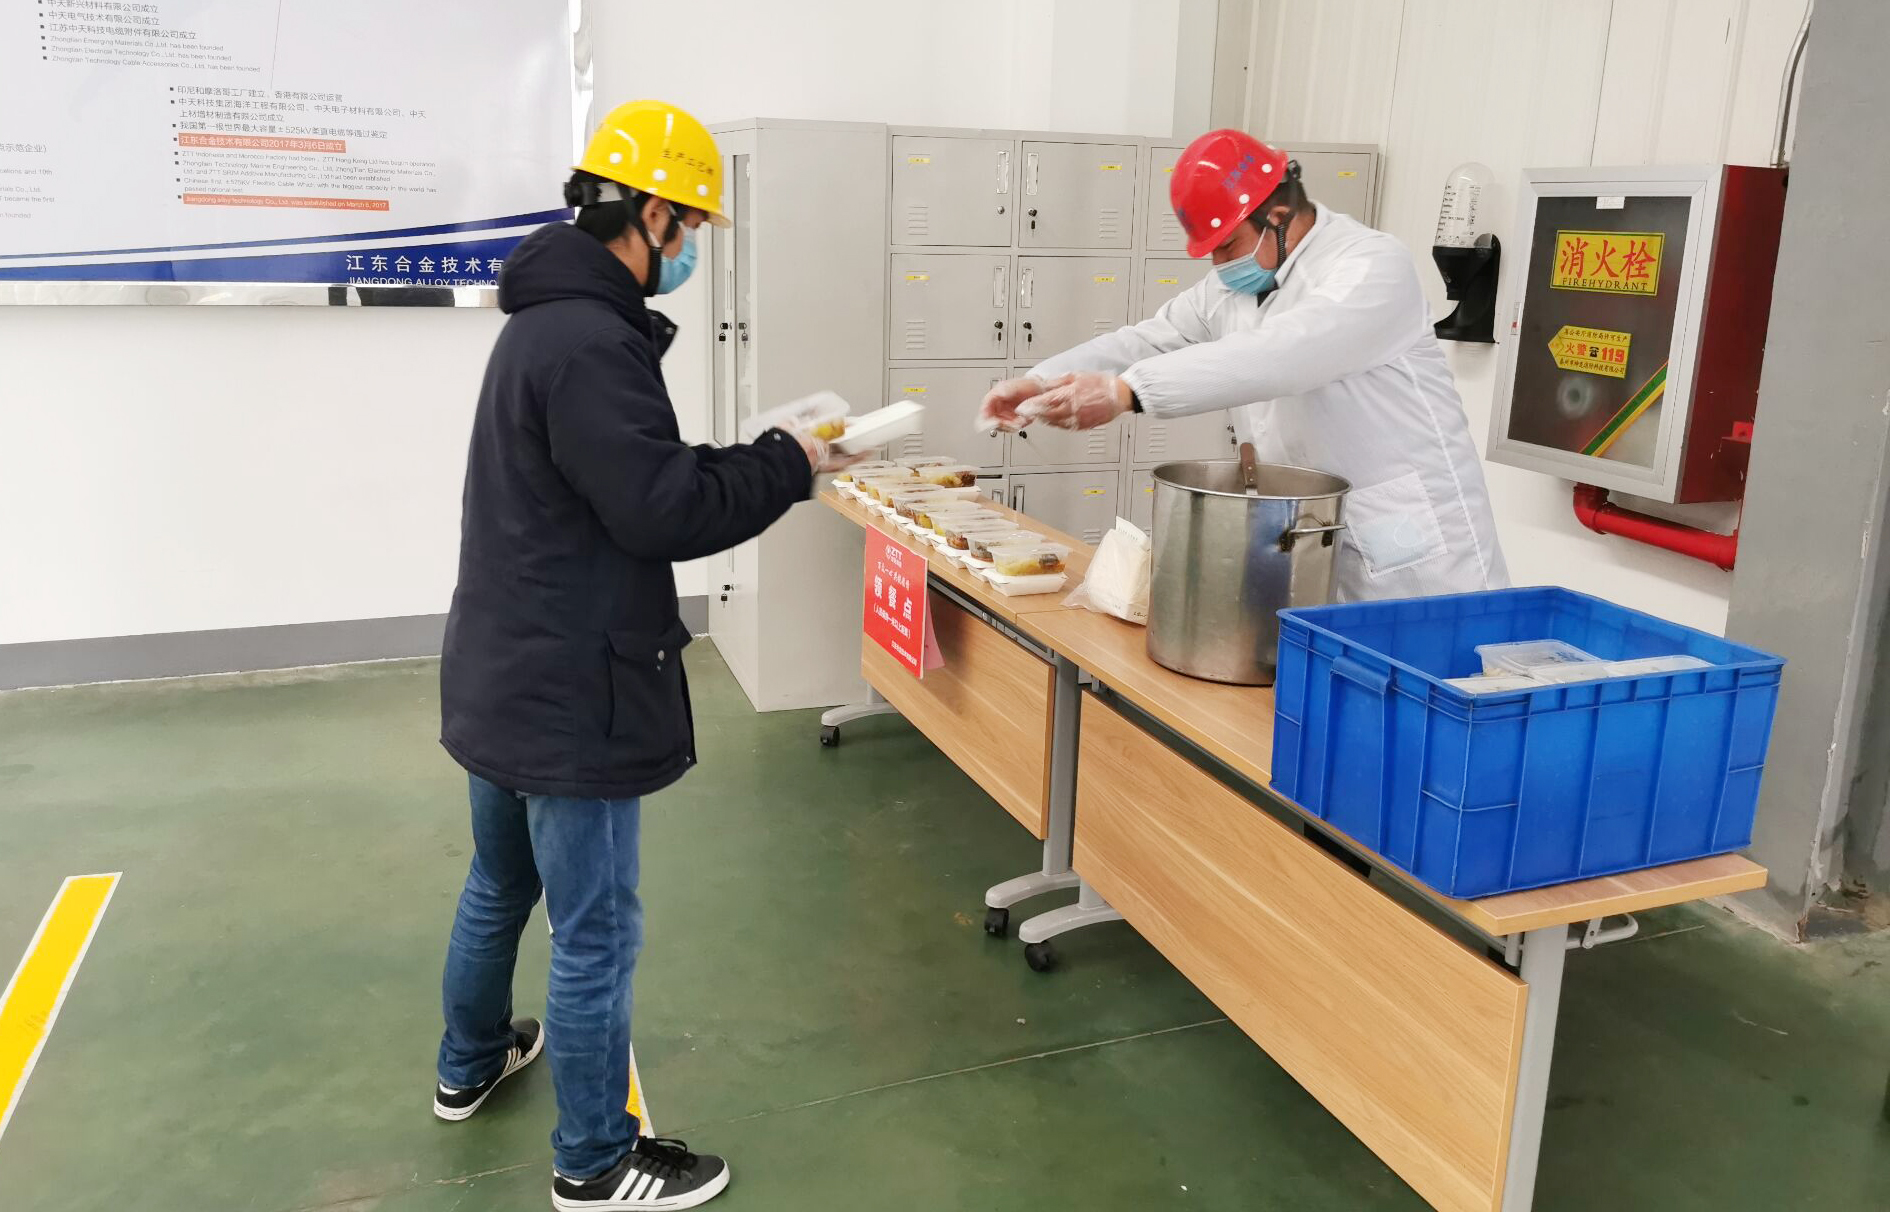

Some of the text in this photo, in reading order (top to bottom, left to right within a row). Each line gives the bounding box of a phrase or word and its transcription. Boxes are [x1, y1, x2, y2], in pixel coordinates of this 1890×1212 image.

[1560, 237, 1656, 281] 消火栓
[1562, 277, 1648, 291] FIREHYDRANT
[1565, 342, 1625, 363] 火警 119
